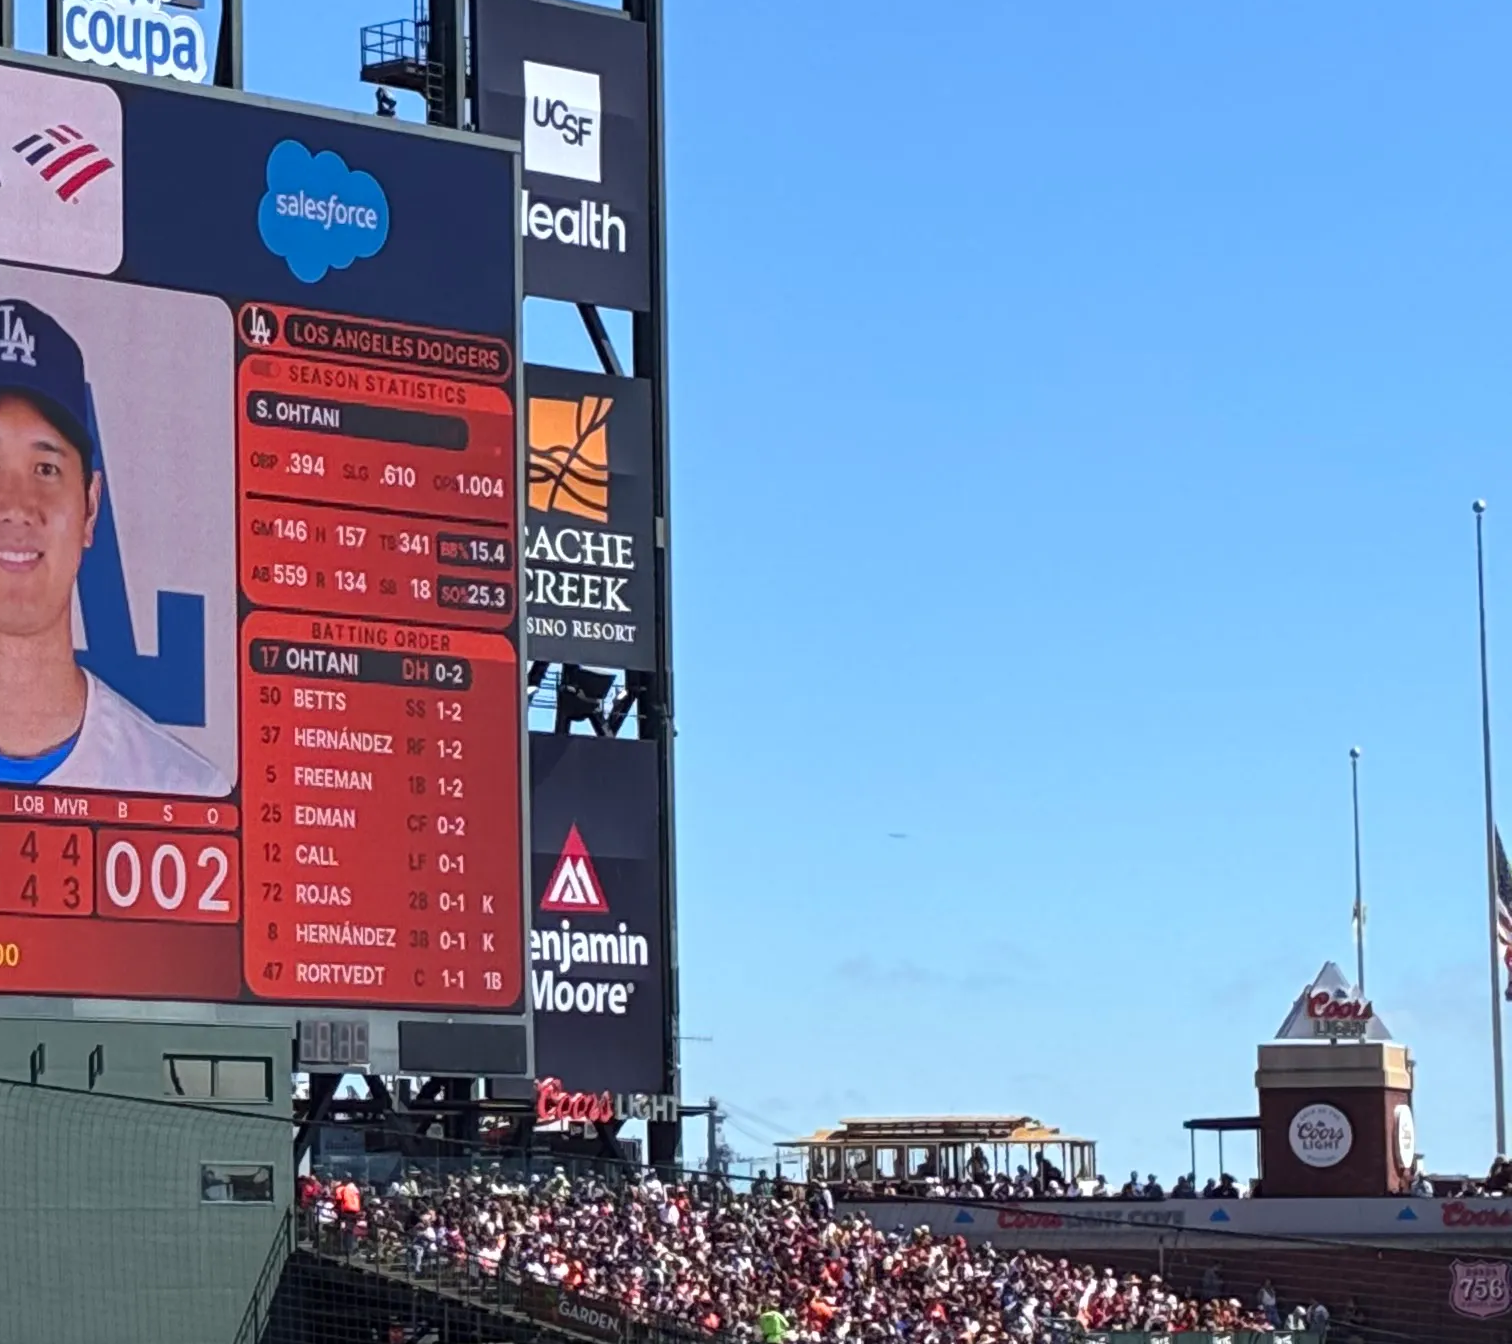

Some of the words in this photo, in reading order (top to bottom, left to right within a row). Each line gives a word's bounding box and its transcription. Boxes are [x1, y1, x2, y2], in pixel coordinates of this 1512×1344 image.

[65, 4, 197, 73] coupa
[533, 95, 593, 147] UCSF
[276, 190, 377, 231] salesforce
[251, 306, 270, 346] LA
[294, 322, 330, 346] LOS
[333, 327, 413, 356] ANGELES
[418, 338, 500, 370] DODGERS
[256, 400, 273, 418] S.
[276, 402, 340, 429] OHTANI
[285, 453, 325, 476] .394
[379, 465, 416, 488] .610
[456, 474, 504, 498] 1.004
[274, 519, 308, 542] 146
[336, 526, 366, 547] 157
[399, 533, 430, 555] 341
[470, 540, 505, 563] 15.4
[524, 524, 634, 570] ACHE
[273, 565, 307, 587] 559
[335, 572, 367, 593] 134
[411, 579, 431, 599] 18
[468, 584, 506, 607] 25.3
[312, 623, 388, 646] BATTING
[394, 631, 450, 651] ORDER
[526, 616, 567, 637] SINO
[573, 620, 636, 643] RESORT
[286, 648, 358, 676] OHTANI
[402, 659, 429, 681] DH
[435, 664, 463, 684] 0-2
[294, 688, 346, 711] BETTS
[438, 702, 462, 721] 1-2
[295, 727, 393, 754] HERNÁNDEZ
[438, 740, 462, 759] 1-2
[295, 766, 372, 791] FREEMAN
[439, 778, 463, 798] 1-2
[14, 795, 45, 814] LOB
[54, 797, 89, 816] MVR
[295, 806, 356, 829] EDMAN
[438, 816, 465, 836] 0-2
[296, 845, 338, 866] CALL
[439, 855, 464, 874] 0-1
[296, 885, 351, 906] ROJAS
[440, 893, 465, 912] 0-1
[296, 921, 397, 948] HERNÁNDEZ
[440, 931, 466, 951] 0-1
[530, 919, 648, 973] enjamin
[296, 964, 385, 986] RORTVEDT
[442, 970, 464, 989] 1-1
[1308, 992, 1372, 1019] Coors
[535, 1077, 612, 1123] Coors
[615, 1093, 679, 1121] LIGHT
[1298, 1122, 1344, 1140] Coors
[1303, 1140, 1338, 1150] LIGHT
[1459, 1278, 1504, 1301] 756
[559, 1301, 619, 1333] GARDEN
